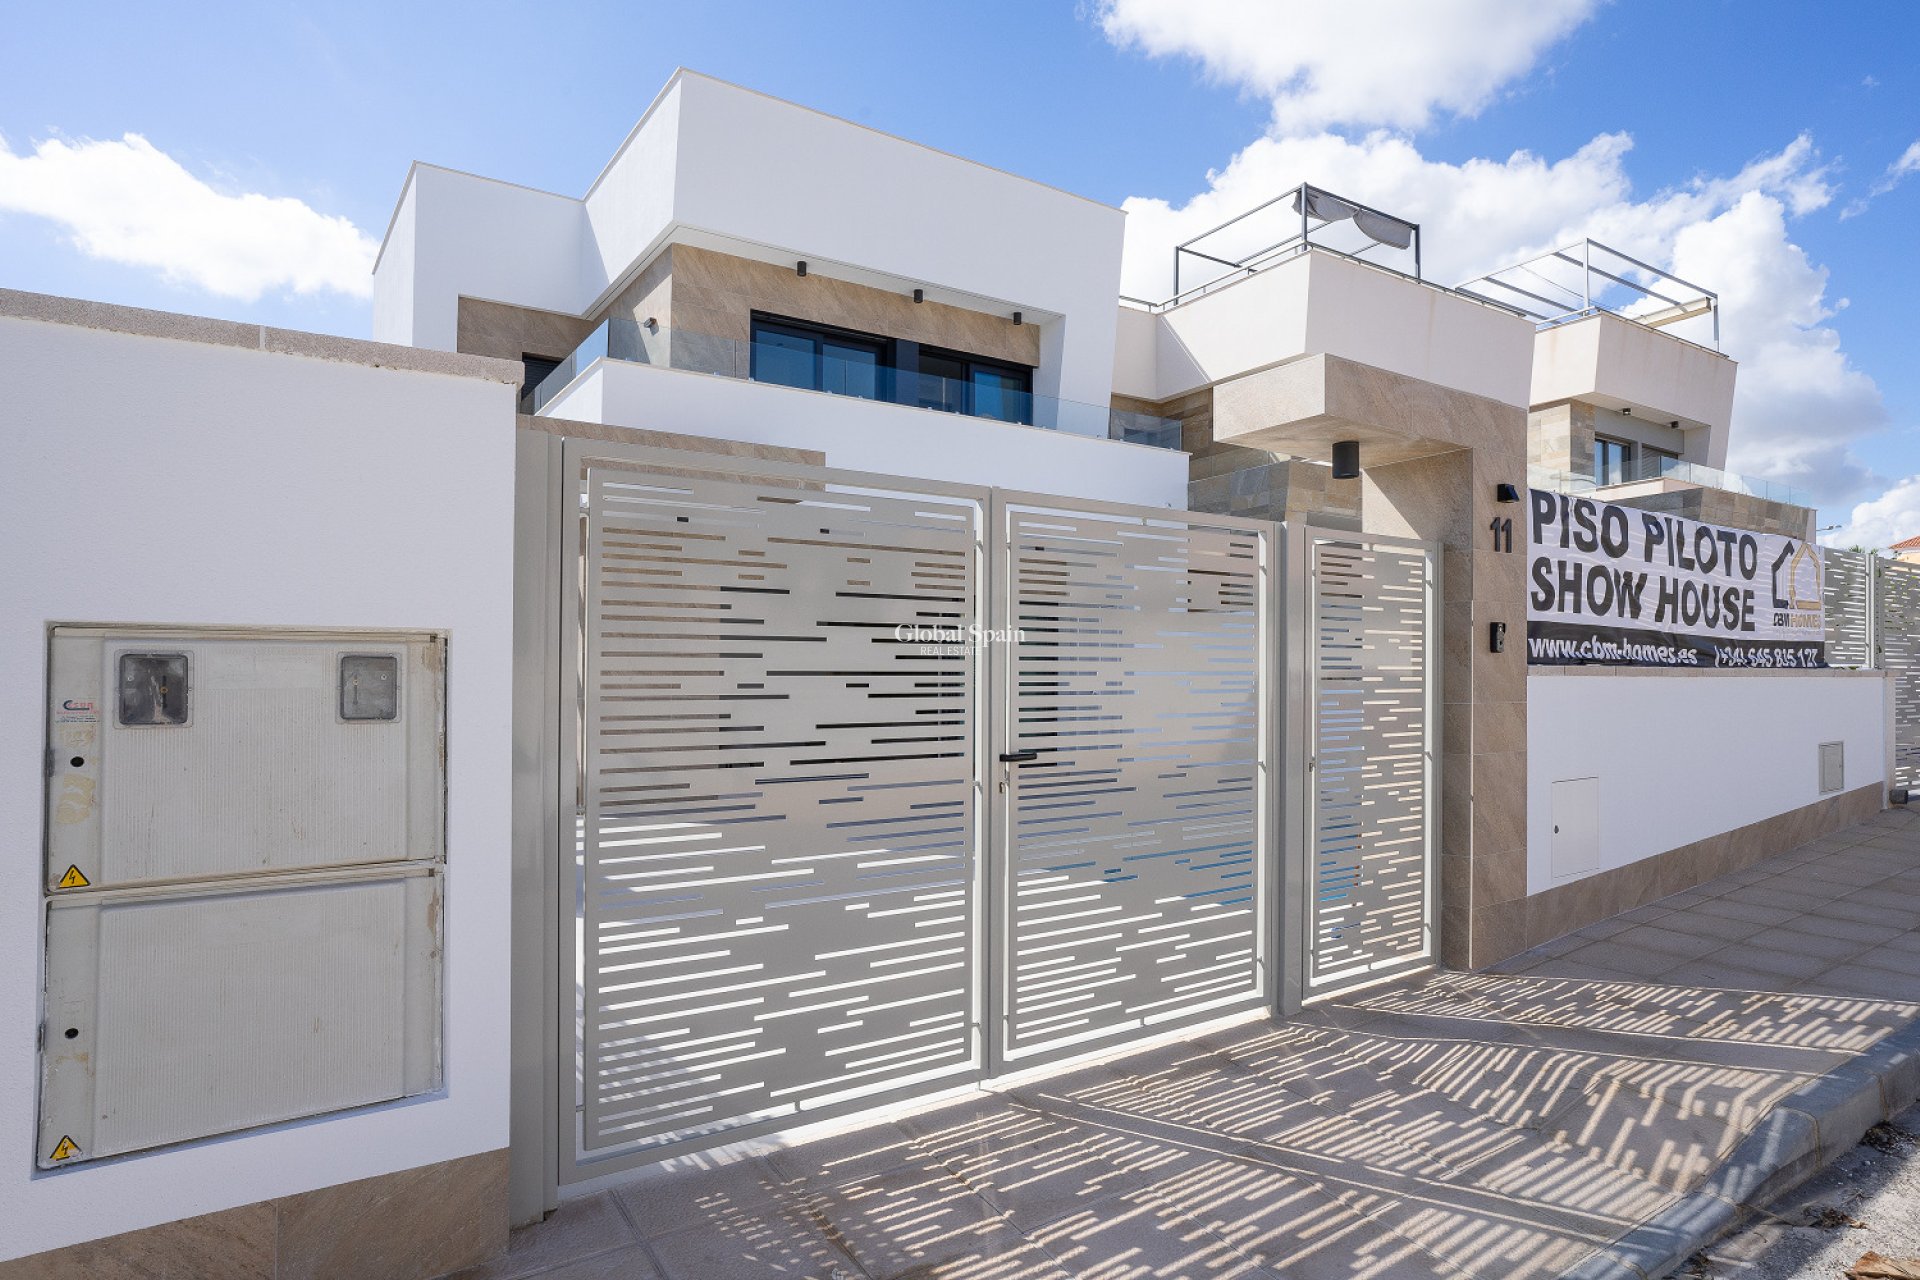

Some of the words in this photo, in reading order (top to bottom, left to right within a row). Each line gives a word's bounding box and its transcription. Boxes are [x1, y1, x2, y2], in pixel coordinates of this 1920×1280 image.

[1490, 517, 1512, 553] 11
[1530, 489, 1628, 558] PISO
[1642, 513, 1757, 580] PILOTO
[1531, 557, 1647, 618] SHOW
[1655, 576, 1755, 631] HOUSE
[1528, 635, 1697, 664] www.cbm-homes.es
